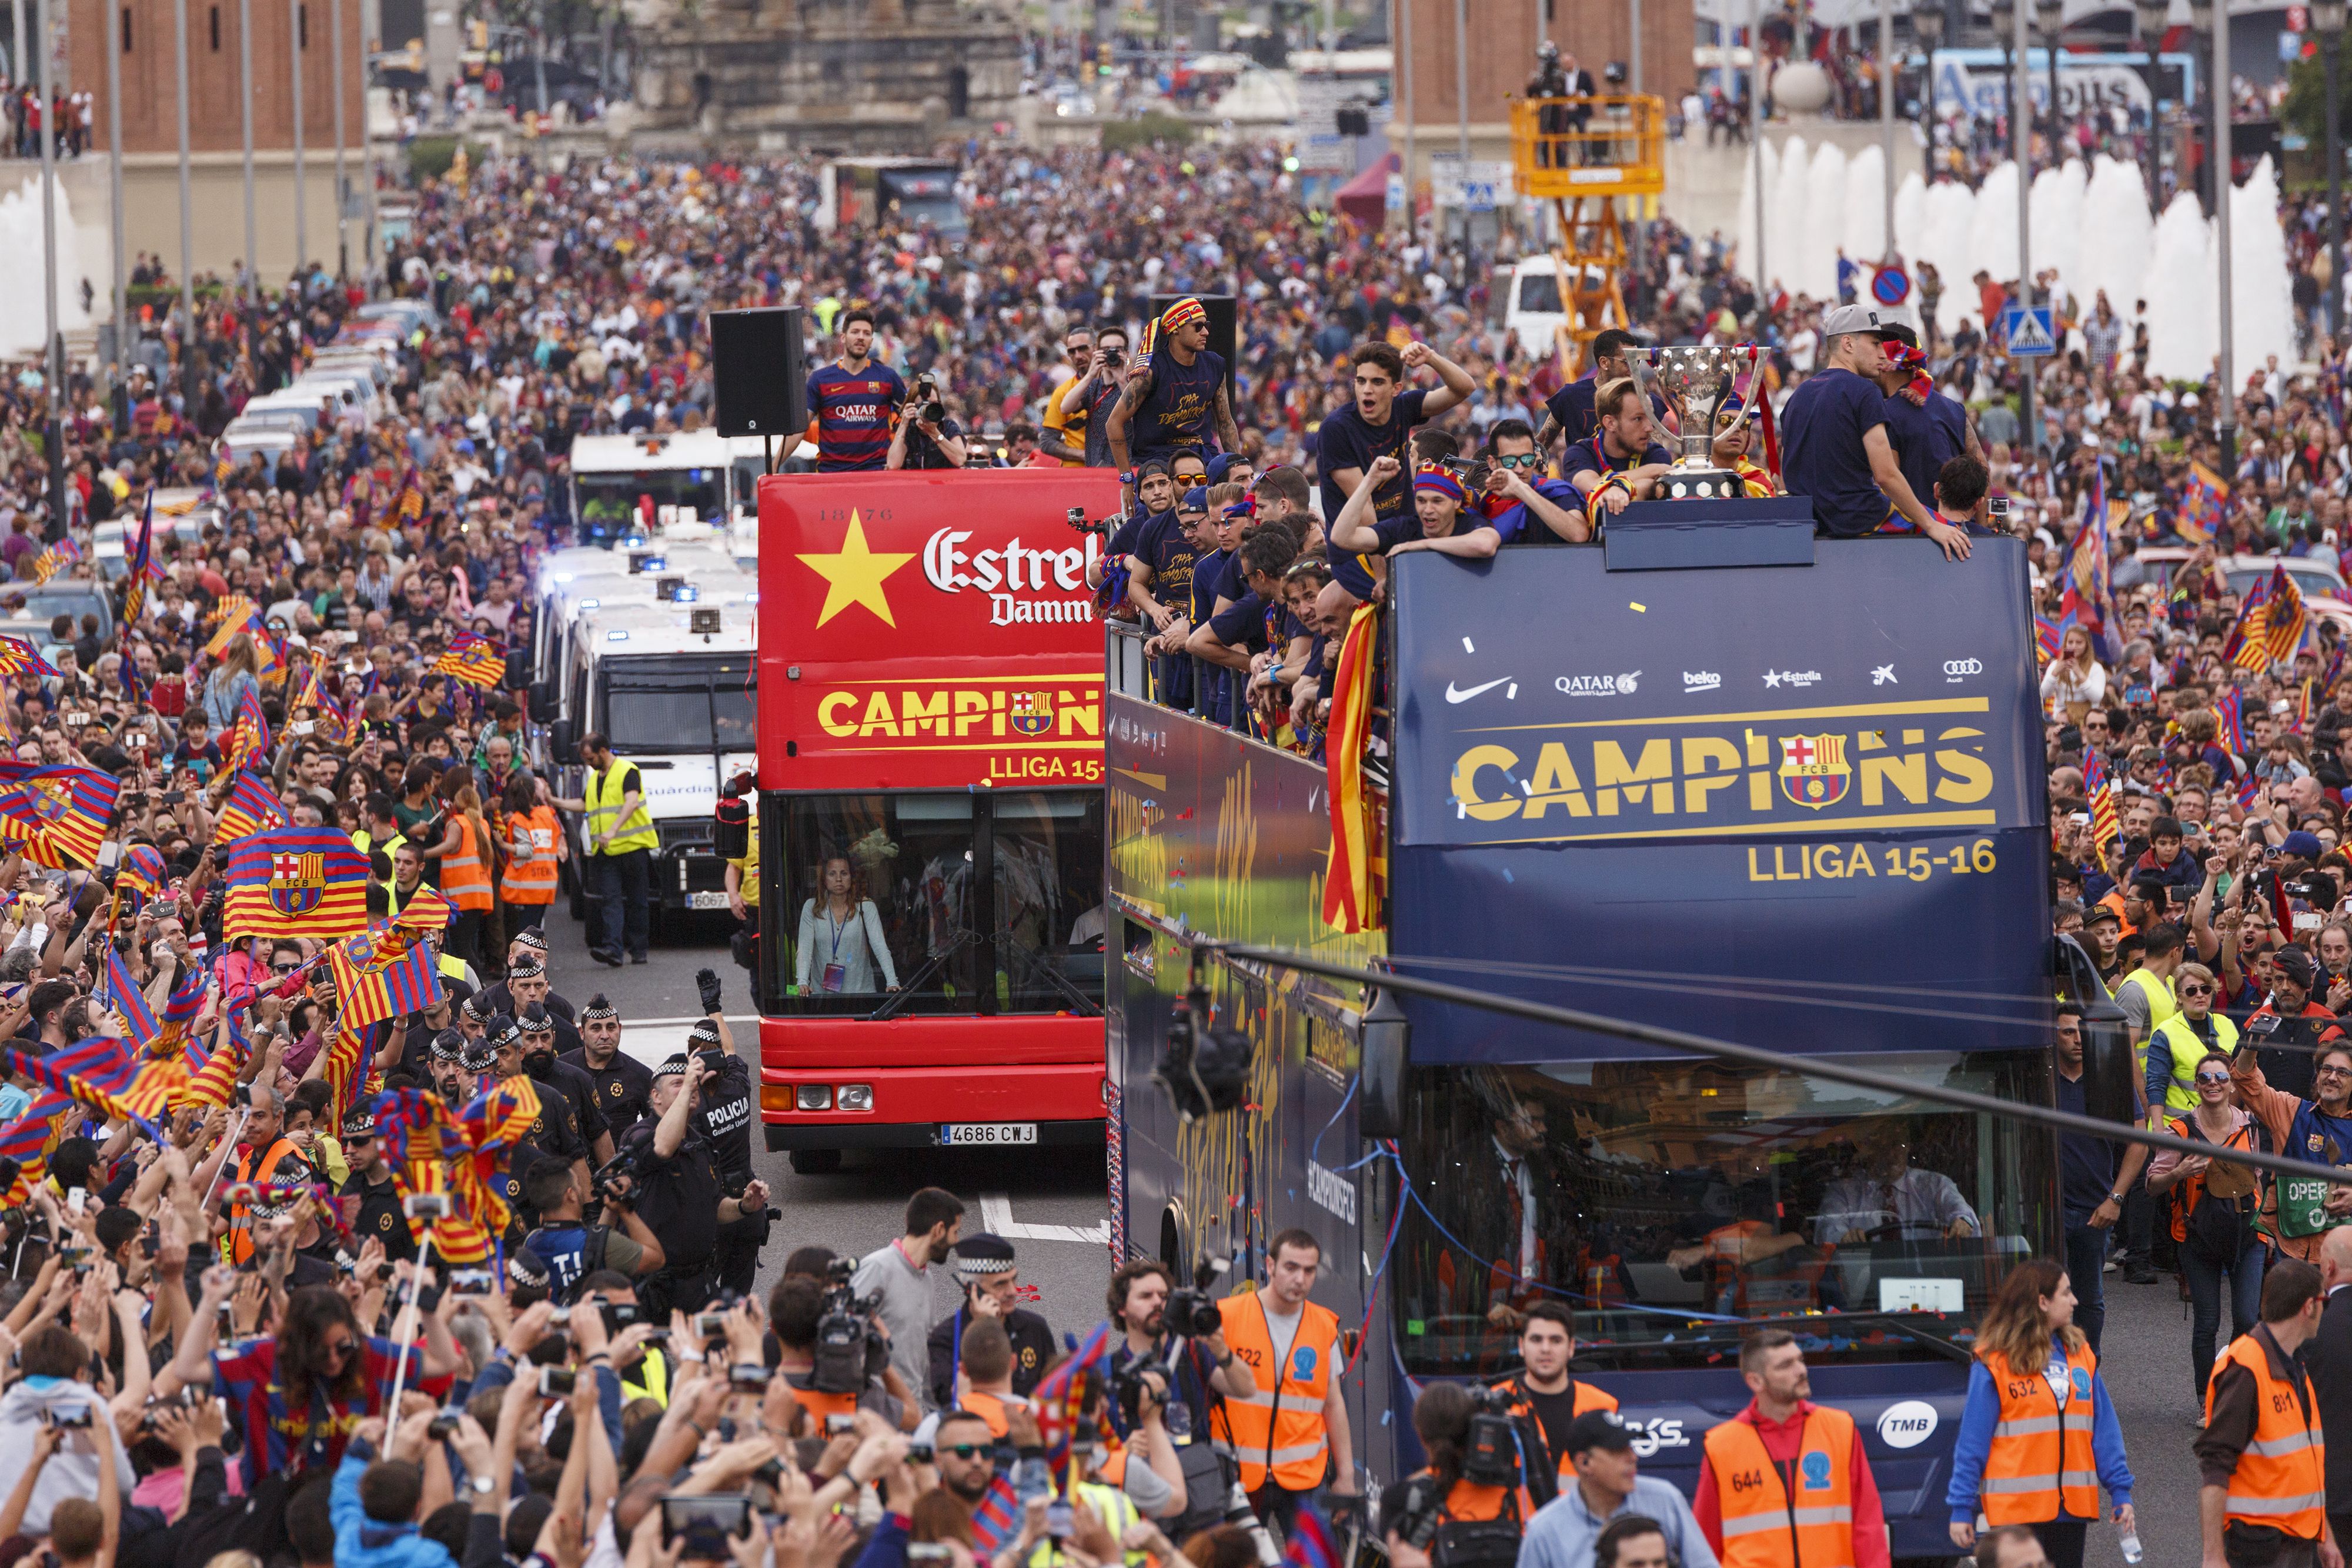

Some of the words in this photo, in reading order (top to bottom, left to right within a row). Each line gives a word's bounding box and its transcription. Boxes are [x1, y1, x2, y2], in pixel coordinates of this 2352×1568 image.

[836, 404, 877, 418] QATAR
[988, 593, 1094, 627] Damm
[1555, 676, 1615, 693] QATAR
[1683, 671, 1722, 684] beko
[1782, 670, 1822, 682] Estrella
[991, 757, 1066, 778] LLIGA
[1451, 727, 1993, 821] CAMPINS
[1748, 843, 1877, 882] LLIGA
[1885, 838, 1997, 882] 15-16
[286, 879, 309, 888] FCB
[695, 895, 725, 907] 6067
[707, 1097, 749, 1128] POLICIA
[712, 1124, 735, 1137] Guàrdia
[954, 1127, 995, 1142] 4686
[1001, 1127, 1033, 1141] CWJ
[1308, 1158, 1355, 1226] #CAMPIONSFCB
[2009, 1378, 2037, 1399] 632
[1890, 1419, 1929, 1432] TMB
[1732, 1469, 1763, 1492] 644
